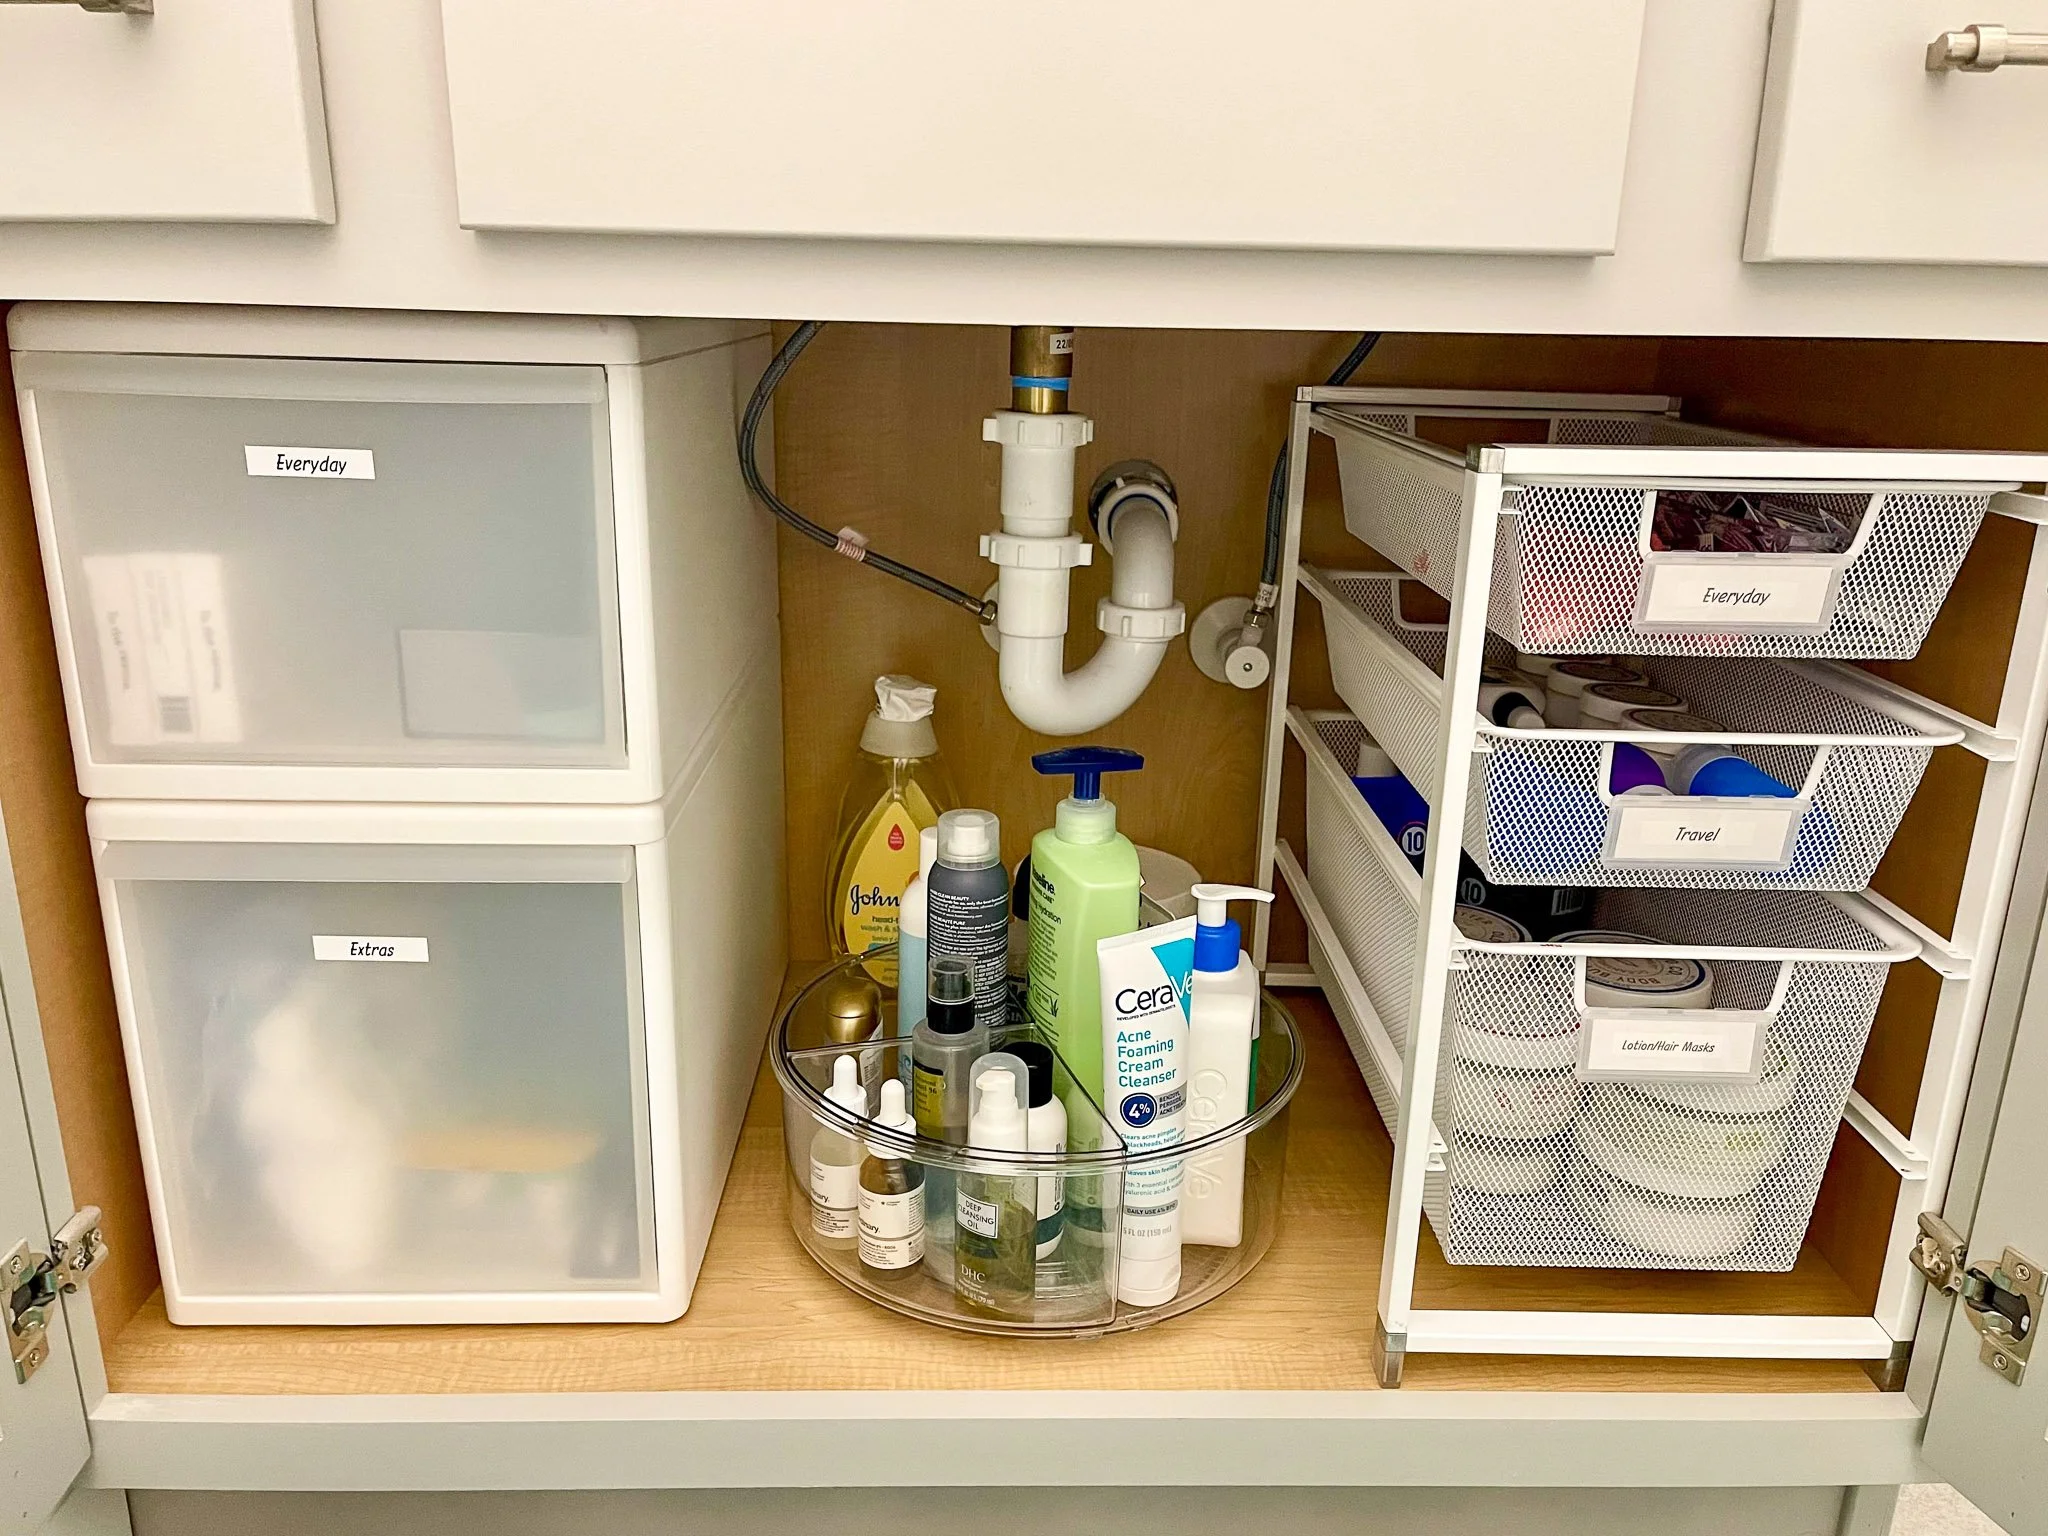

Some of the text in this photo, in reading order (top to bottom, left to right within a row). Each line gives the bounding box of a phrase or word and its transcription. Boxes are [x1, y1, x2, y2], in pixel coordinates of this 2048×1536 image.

[276, 453, 347, 475] Everyday
[1702, 587, 1771, 606] Everyday
[1407, 831, 1425, 852] 10
[1675, 827, 1721, 841] Travel
[850, 884, 900, 915] John
[1464, 880, 1482, 904] 10
[350, 941, 395, 957] Extras
[1115, 971, 1193, 1014] CeraVe
[1117, 1030, 1151, 1043] Acne
[1118, 1039, 1174, 1058] Foaming
[1621, 1039, 1716, 1054] Lotion/Hair Masks
[1118, 1058, 1164, 1073] Cream
[1118, 1068, 1177, 1088] Cleanser
[1128, 1102, 1152, 1119] 4%
[958, 1203, 995, 1225] CLEANSING
[965, 1201, 982, 1211] DEEP
[1126, 1207, 1143, 1215] DAILY
[967, 1219, 979, 1230] OIL
[961, 1263, 986, 1283] DHC
